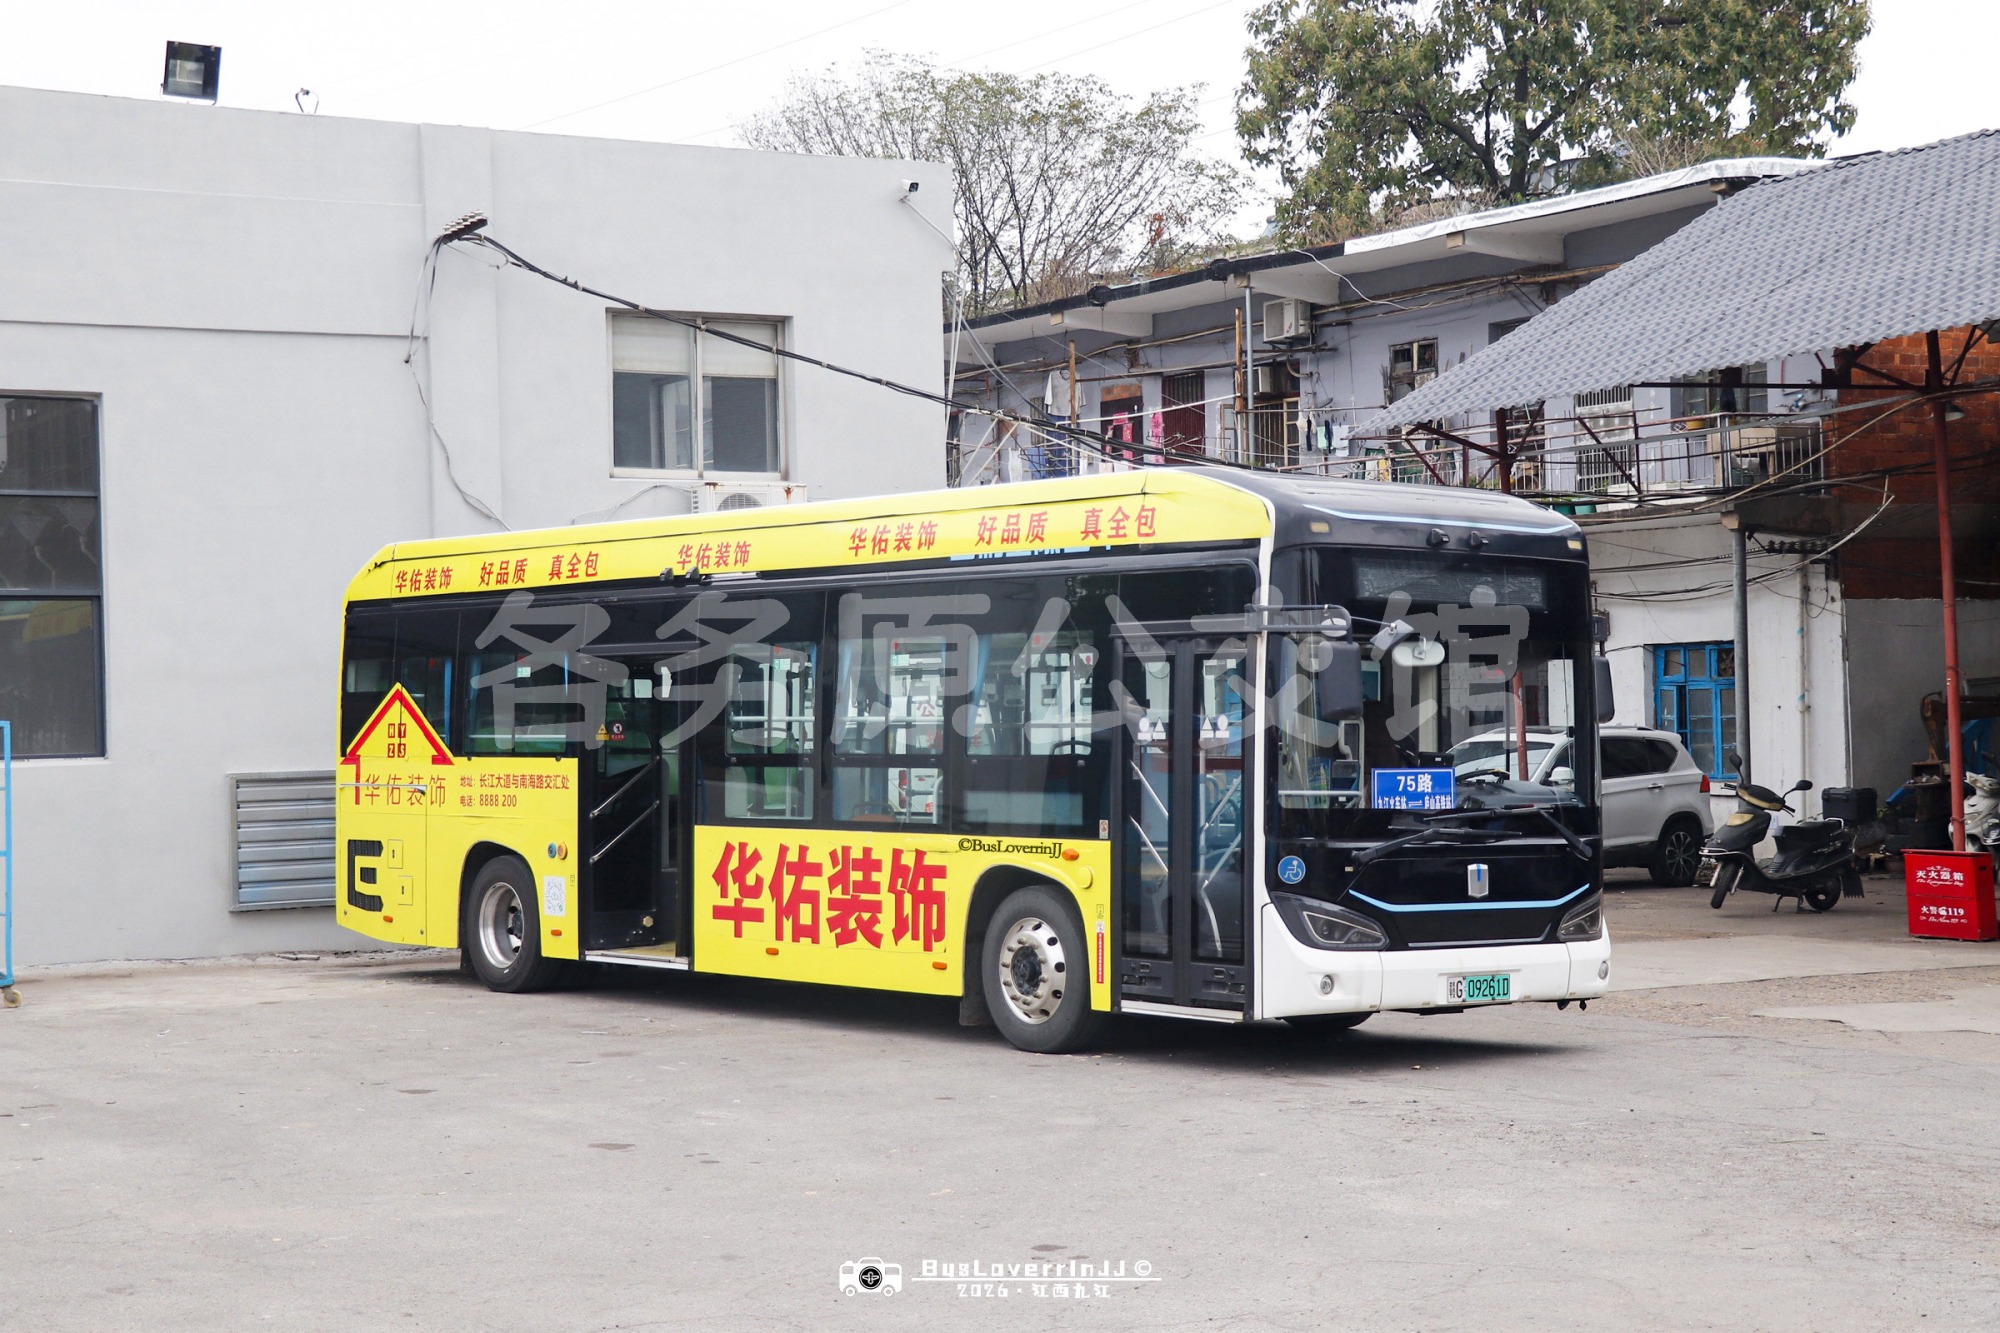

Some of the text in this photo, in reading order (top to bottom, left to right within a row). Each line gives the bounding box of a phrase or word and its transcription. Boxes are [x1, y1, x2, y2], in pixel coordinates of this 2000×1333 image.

[849, 523, 936, 556] 华佑装饰
[976, 511, 1047, 545] 好品质
[1080, 504, 1157, 541] 真全包
[395, 551, 599, 592] 华佑装饰 好品质 真全包
[677, 542, 751, 569] 华佑装饰
[364, 773, 447, 808] 华佑装饰
[1396, 773, 1433, 793] 75路
[712, 840, 948, 952] 华佑装饰
